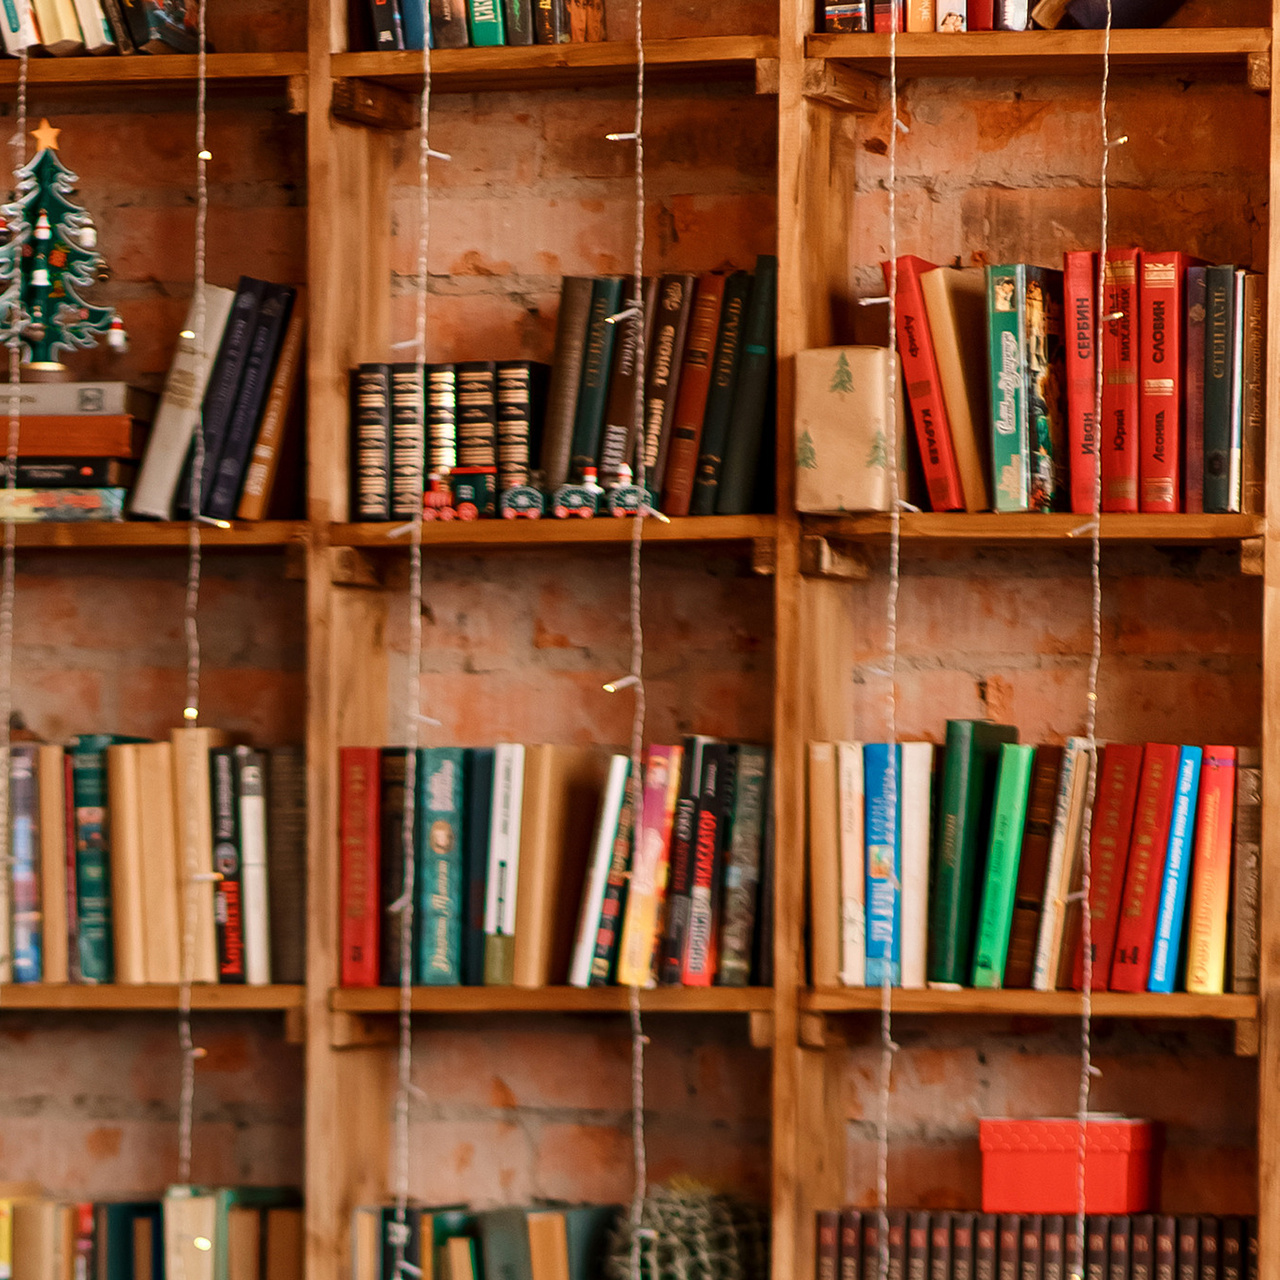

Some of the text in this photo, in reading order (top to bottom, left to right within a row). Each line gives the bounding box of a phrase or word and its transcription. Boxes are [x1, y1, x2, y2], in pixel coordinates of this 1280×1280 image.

[655, 325, 675, 387] ТОПОЛЬ
[717, 296, 743, 388] СТЕНДАЛЬ
[1213, 286, 1227, 379] СТЕНДАЛЬ
[1249, 297, 1262, 329] Мень
[902, 314, 940, 465] Ариф КАРАЕВ
[1077, 296, 1095, 456] Иван СЕРБИН
[1152, 300, 1166, 463] Леонид СЛОВИН
[1248, 331, 1263, 393] Александр
[1113, 409, 1127, 452] Юрий
